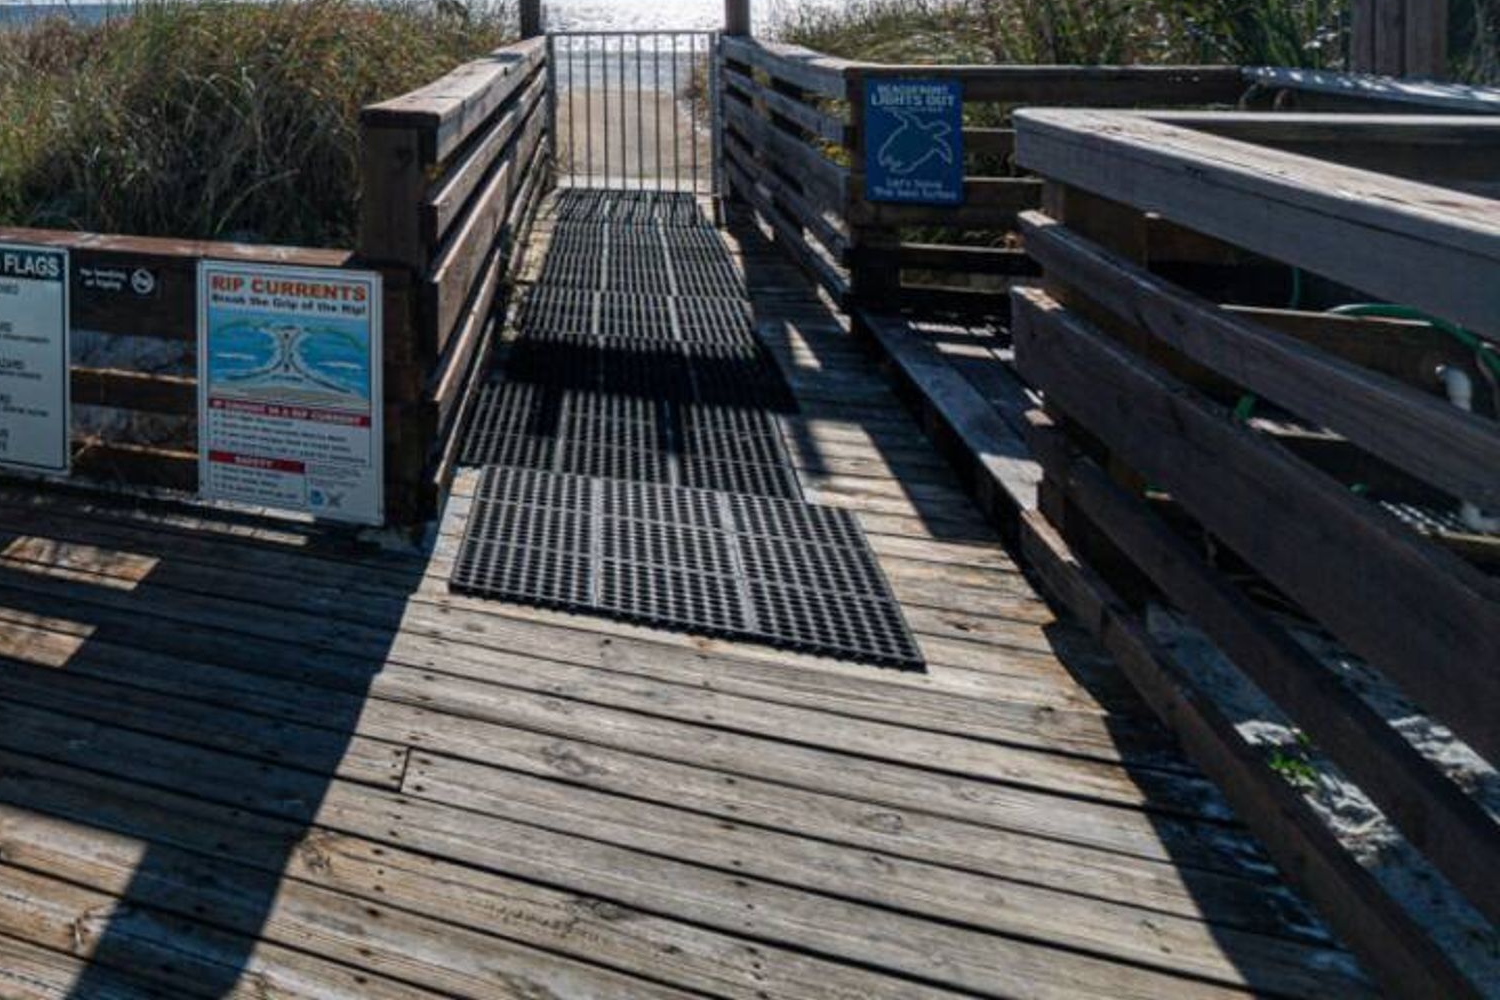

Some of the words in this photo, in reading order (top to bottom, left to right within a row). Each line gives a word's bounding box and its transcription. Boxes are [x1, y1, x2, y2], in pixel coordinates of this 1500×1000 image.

[871, 92, 922, 106] LIGHTS
[925, 95, 954, 107] OUT
[4, 254, 60, 277] FLAGS
[211, 275, 244, 291] RIP
[251, 279, 366, 302] CURRENTS
[250, 295, 270, 306] the
[273, 297, 298, 311] Grip
[301, 299, 314, 310] of
[317, 301, 337, 313] the
